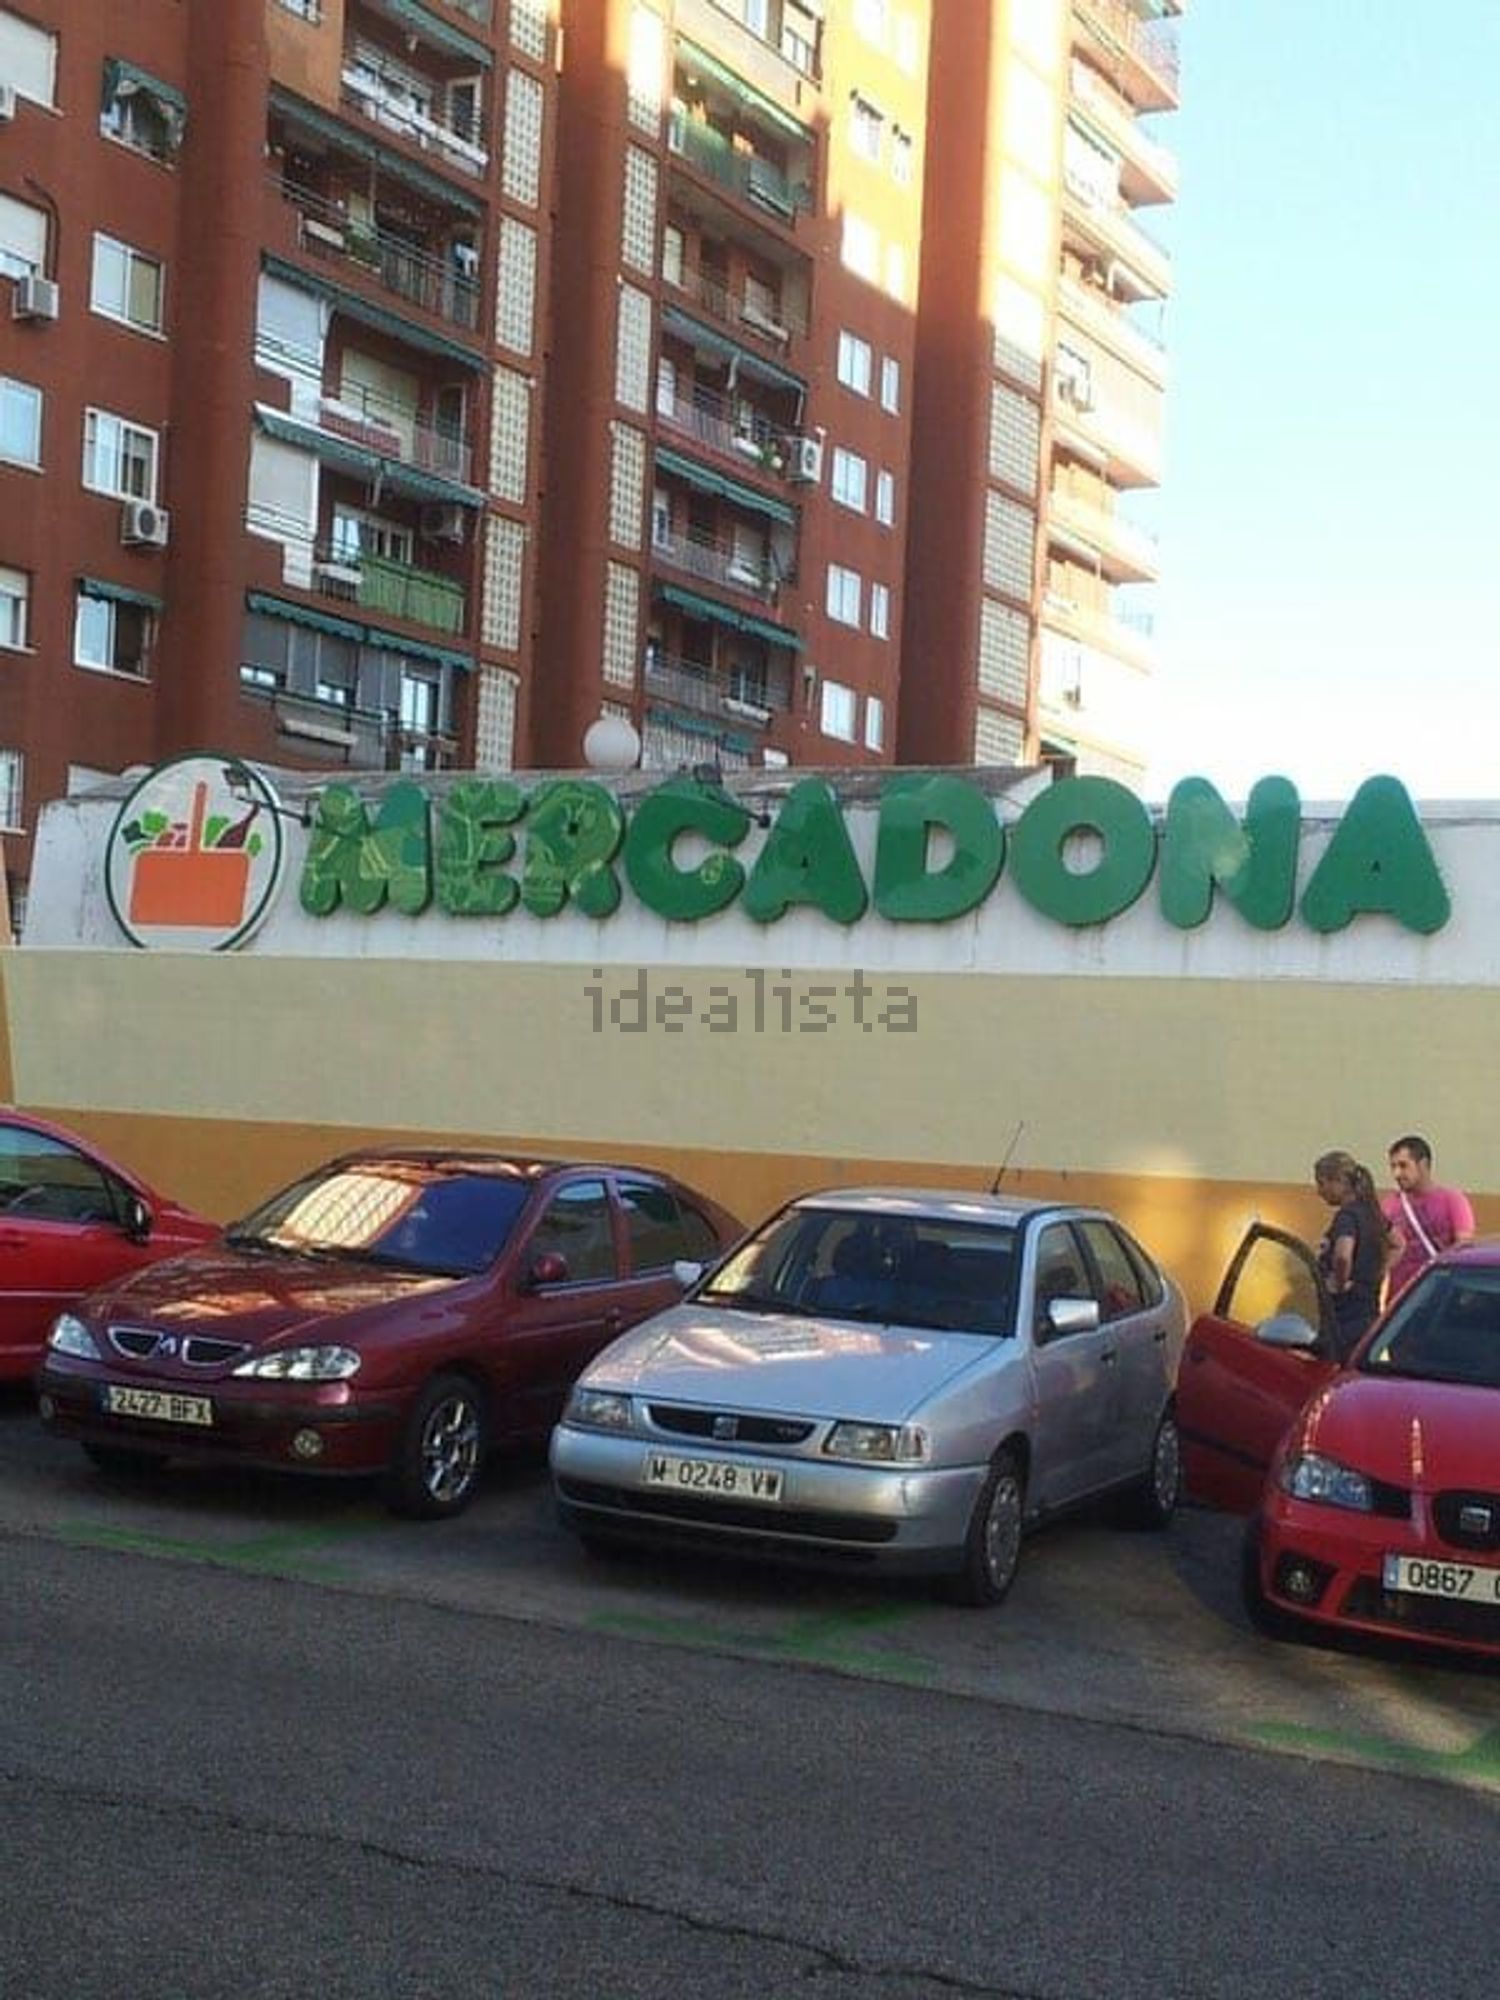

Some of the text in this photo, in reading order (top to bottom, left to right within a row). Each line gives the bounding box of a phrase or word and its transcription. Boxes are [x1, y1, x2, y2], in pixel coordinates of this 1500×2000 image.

[300, 773, 1453, 936] MERCADONA
[114, 1388, 162, 1414] 2427
[652, 1459, 667, 1482] M
[679, 1461, 738, 1491] 0248
[1408, 1561, 1474, 1595] 0867
